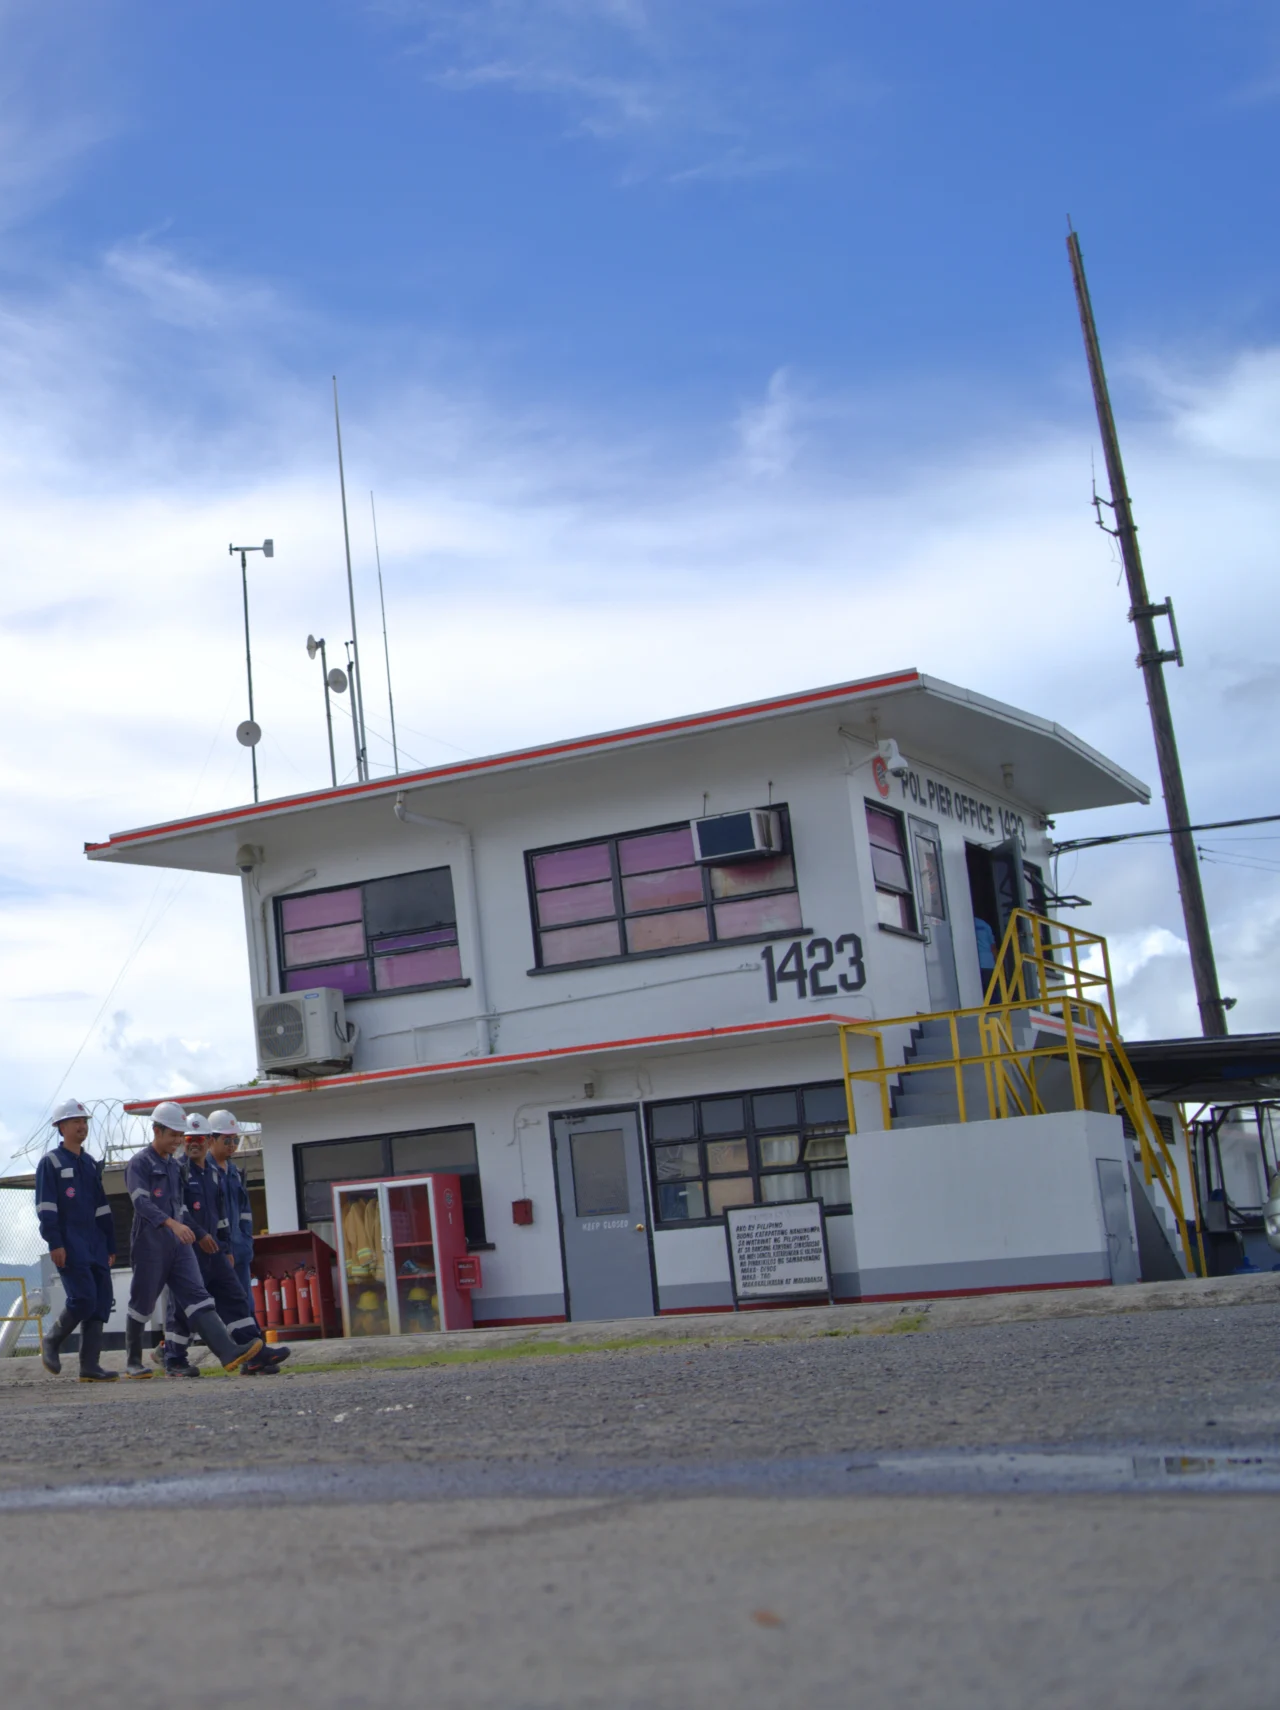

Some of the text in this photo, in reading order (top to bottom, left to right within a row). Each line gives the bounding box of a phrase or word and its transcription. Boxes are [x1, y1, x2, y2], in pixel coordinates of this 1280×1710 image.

[901, 771, 927, 807] POL
[926, 778, 954, 819] PIER
[954, 791, 995, 836] OFFICE
[761, 932, 866, 1004] 1423
[582, 1219, 629, 1232] KEEP CLOSED
[756, 1222, 783, 1230] PILIPINO
[737, 1232, 753, 1240] BUONG
[746, 1238, 772, 1246] WATAWAT
